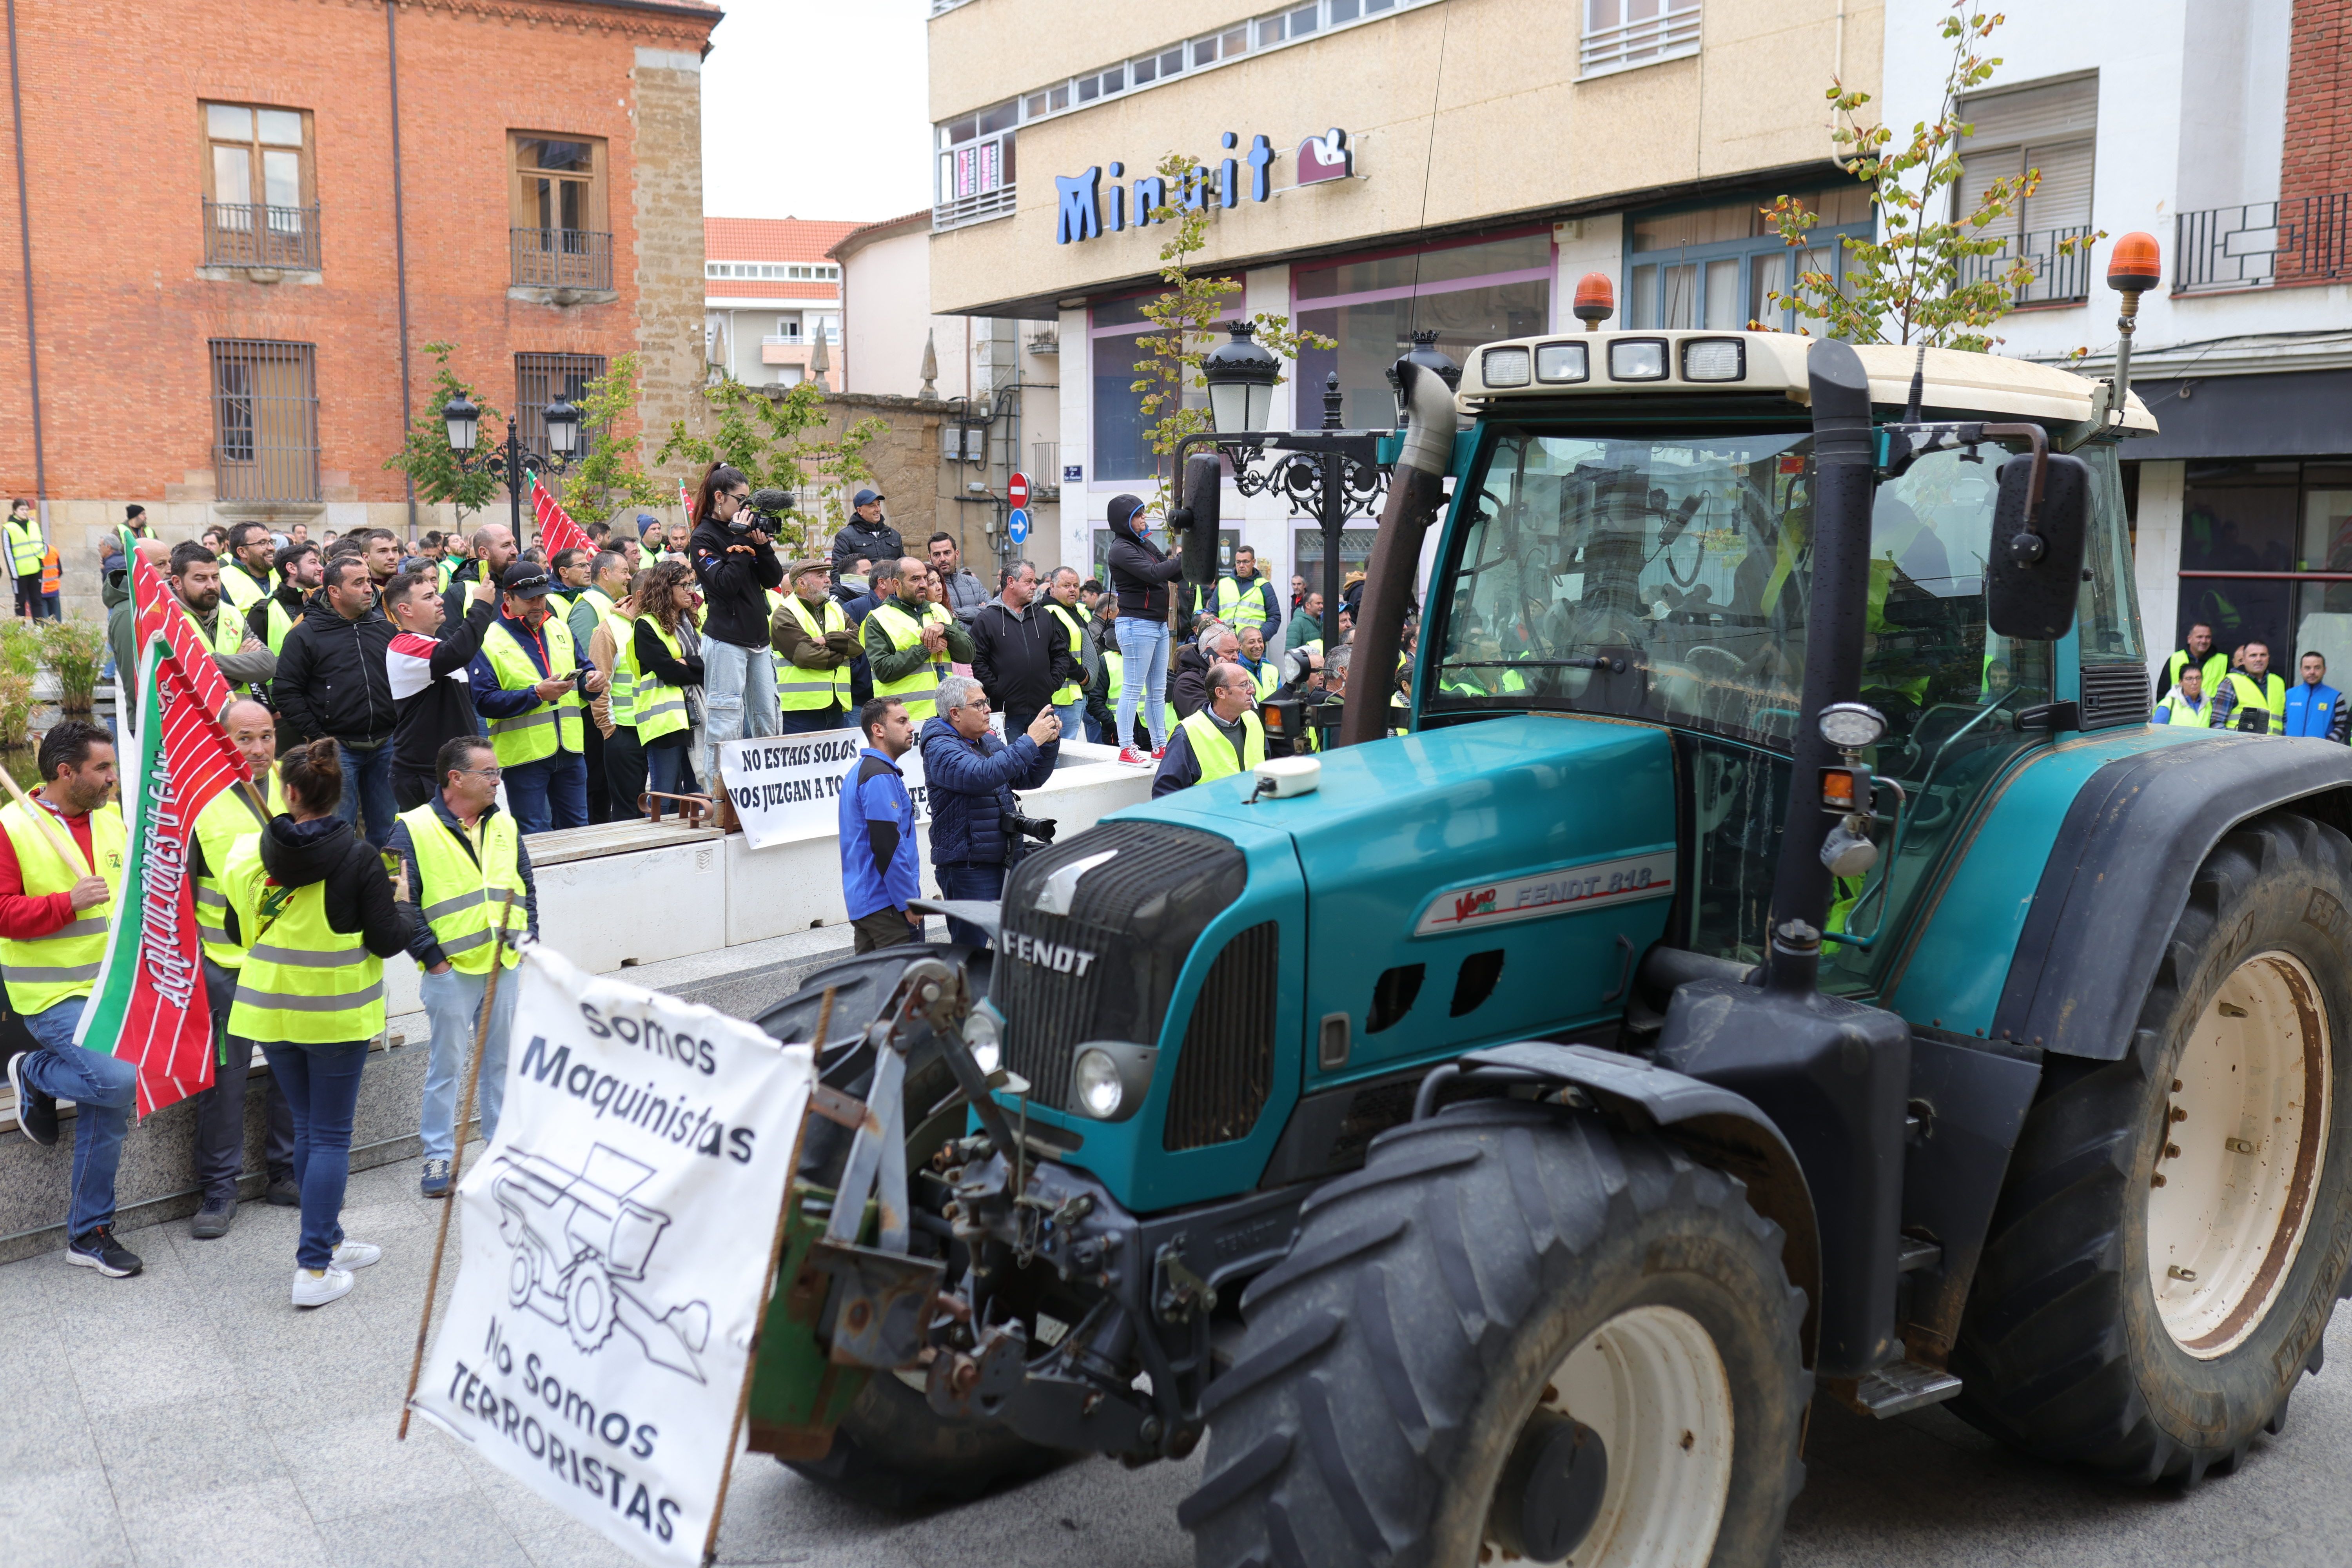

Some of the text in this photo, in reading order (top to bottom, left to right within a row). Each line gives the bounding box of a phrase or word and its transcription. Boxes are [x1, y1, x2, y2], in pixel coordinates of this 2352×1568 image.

[1055, 131, 1275, 244] Minuit
[742, 739, 857, 772] NO ESTAIS SOLOS
[762, 779, 811, 813] JUZGAN
[815, 778, 824, 799] A
[140, 826, 194, 1010] AGRICULTORES
[1514, 867, 1652, 909] FENDT 818
[1002, 929, 1097, 978] FENDT
[519, 1035, 755, 1163] Maquinistas
[484, 1315, 658, 1461] No Somos
[447, 1360, 681, 1544] TERRORISTAS
